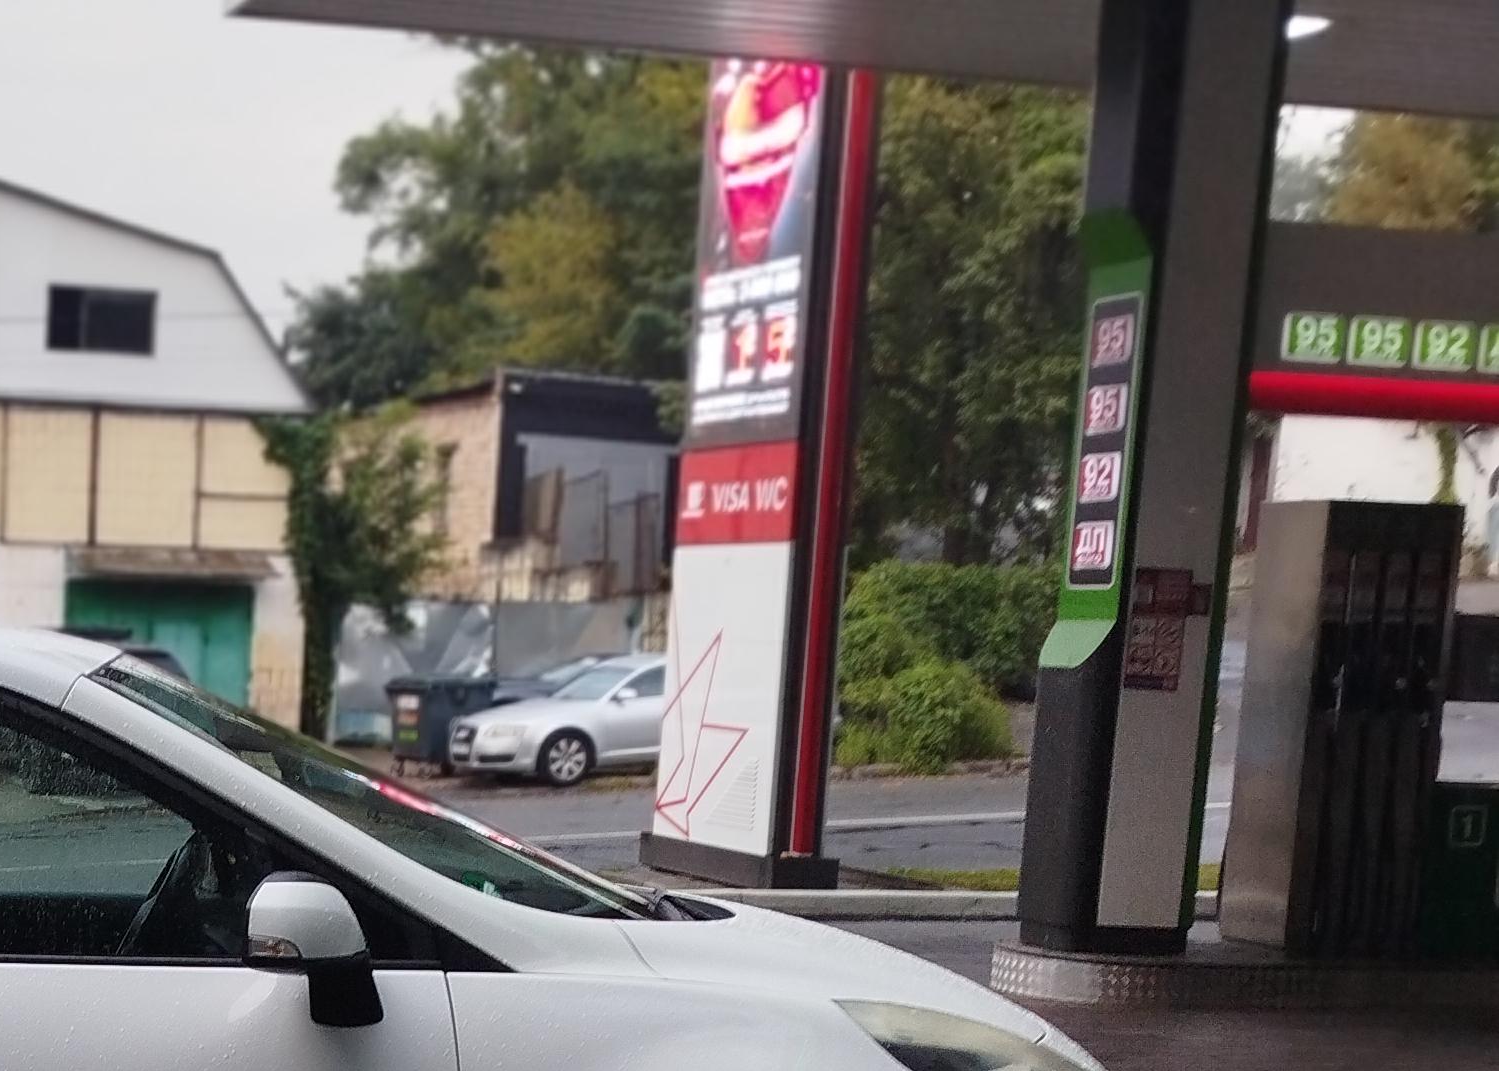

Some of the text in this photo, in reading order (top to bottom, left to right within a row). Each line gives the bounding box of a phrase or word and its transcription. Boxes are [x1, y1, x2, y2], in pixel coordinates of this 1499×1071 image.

[1097, 317, 1125, 351] 95
[1296, 315, 1338, 350] 95
[1362, 319, 1404, 353] 95
[1427, 324, 1470, 356] 92
[1090, 386, 1119, 421] 95
[1083, 455, 1112, 489] 92
[711, 475, 789, 513] VISA WC
[1462, 814, 1473, 839] 1
